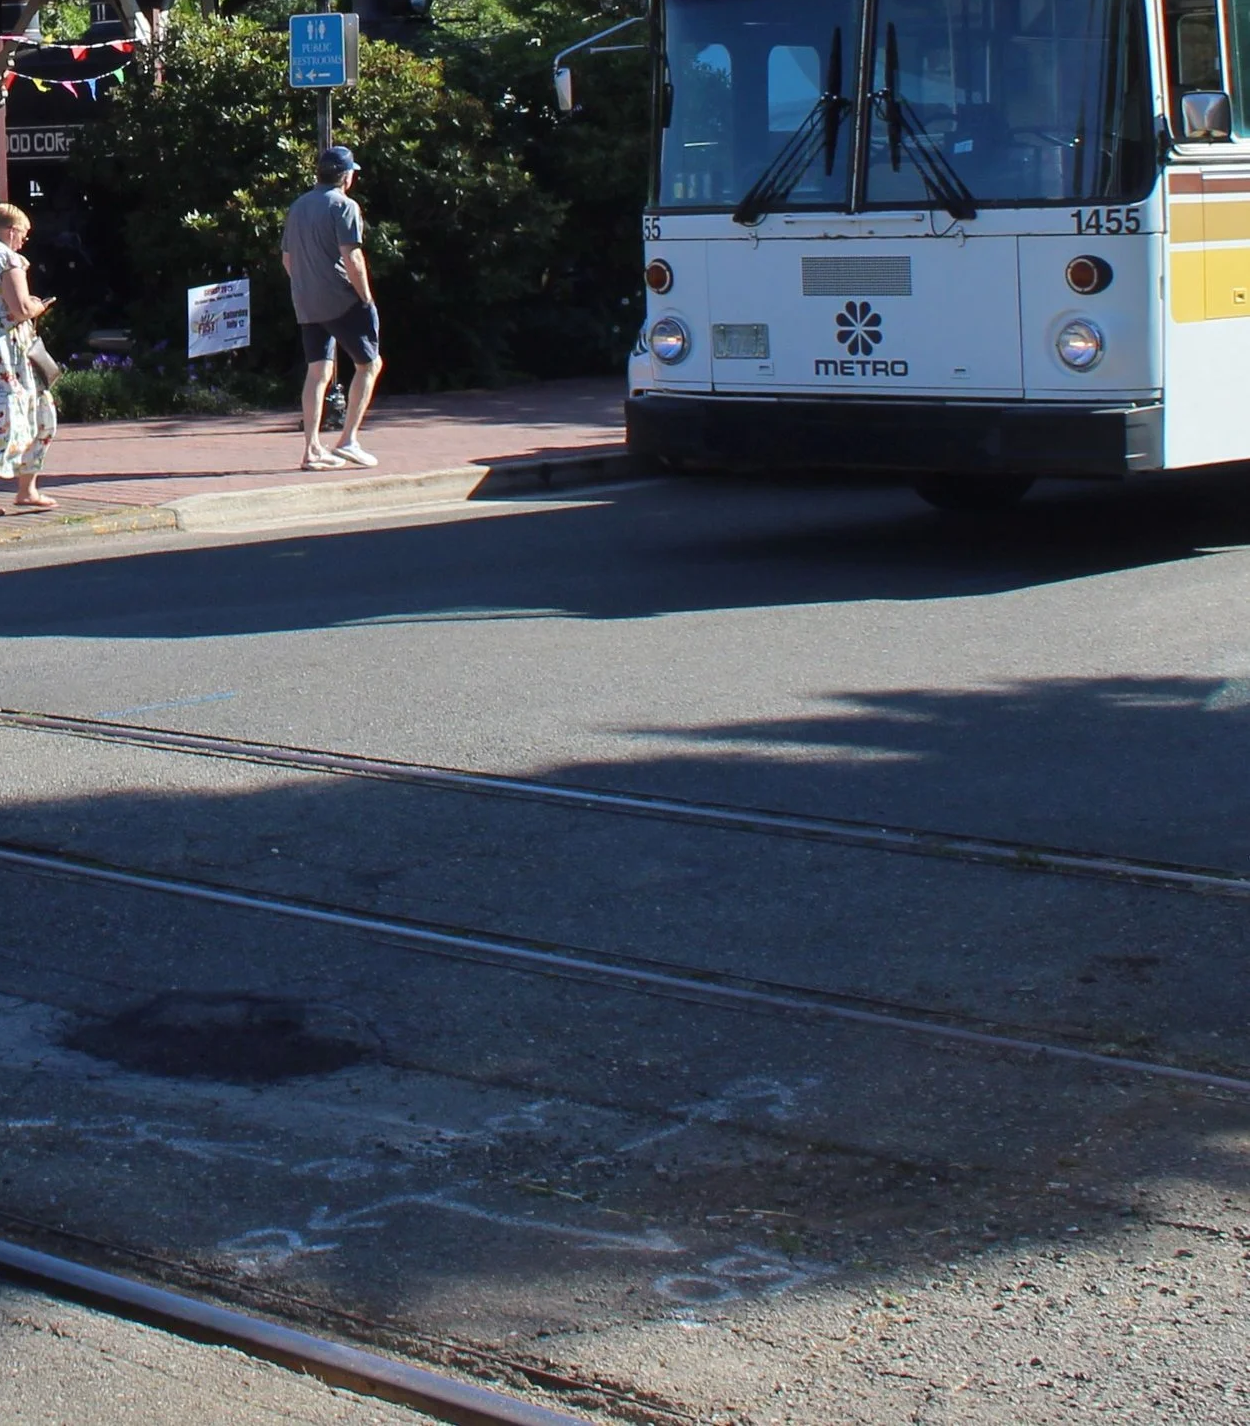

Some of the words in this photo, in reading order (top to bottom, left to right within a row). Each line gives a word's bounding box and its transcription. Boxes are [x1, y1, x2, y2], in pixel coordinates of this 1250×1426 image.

[301, 42, 332, 53] PUBLIC
[292, 55, 343, 66] RESTROOMS
[1070, 207, 1141, 235] 1455
[223, 308, 249, 321] Saturday
[814, 358, 909, 377] METRO
